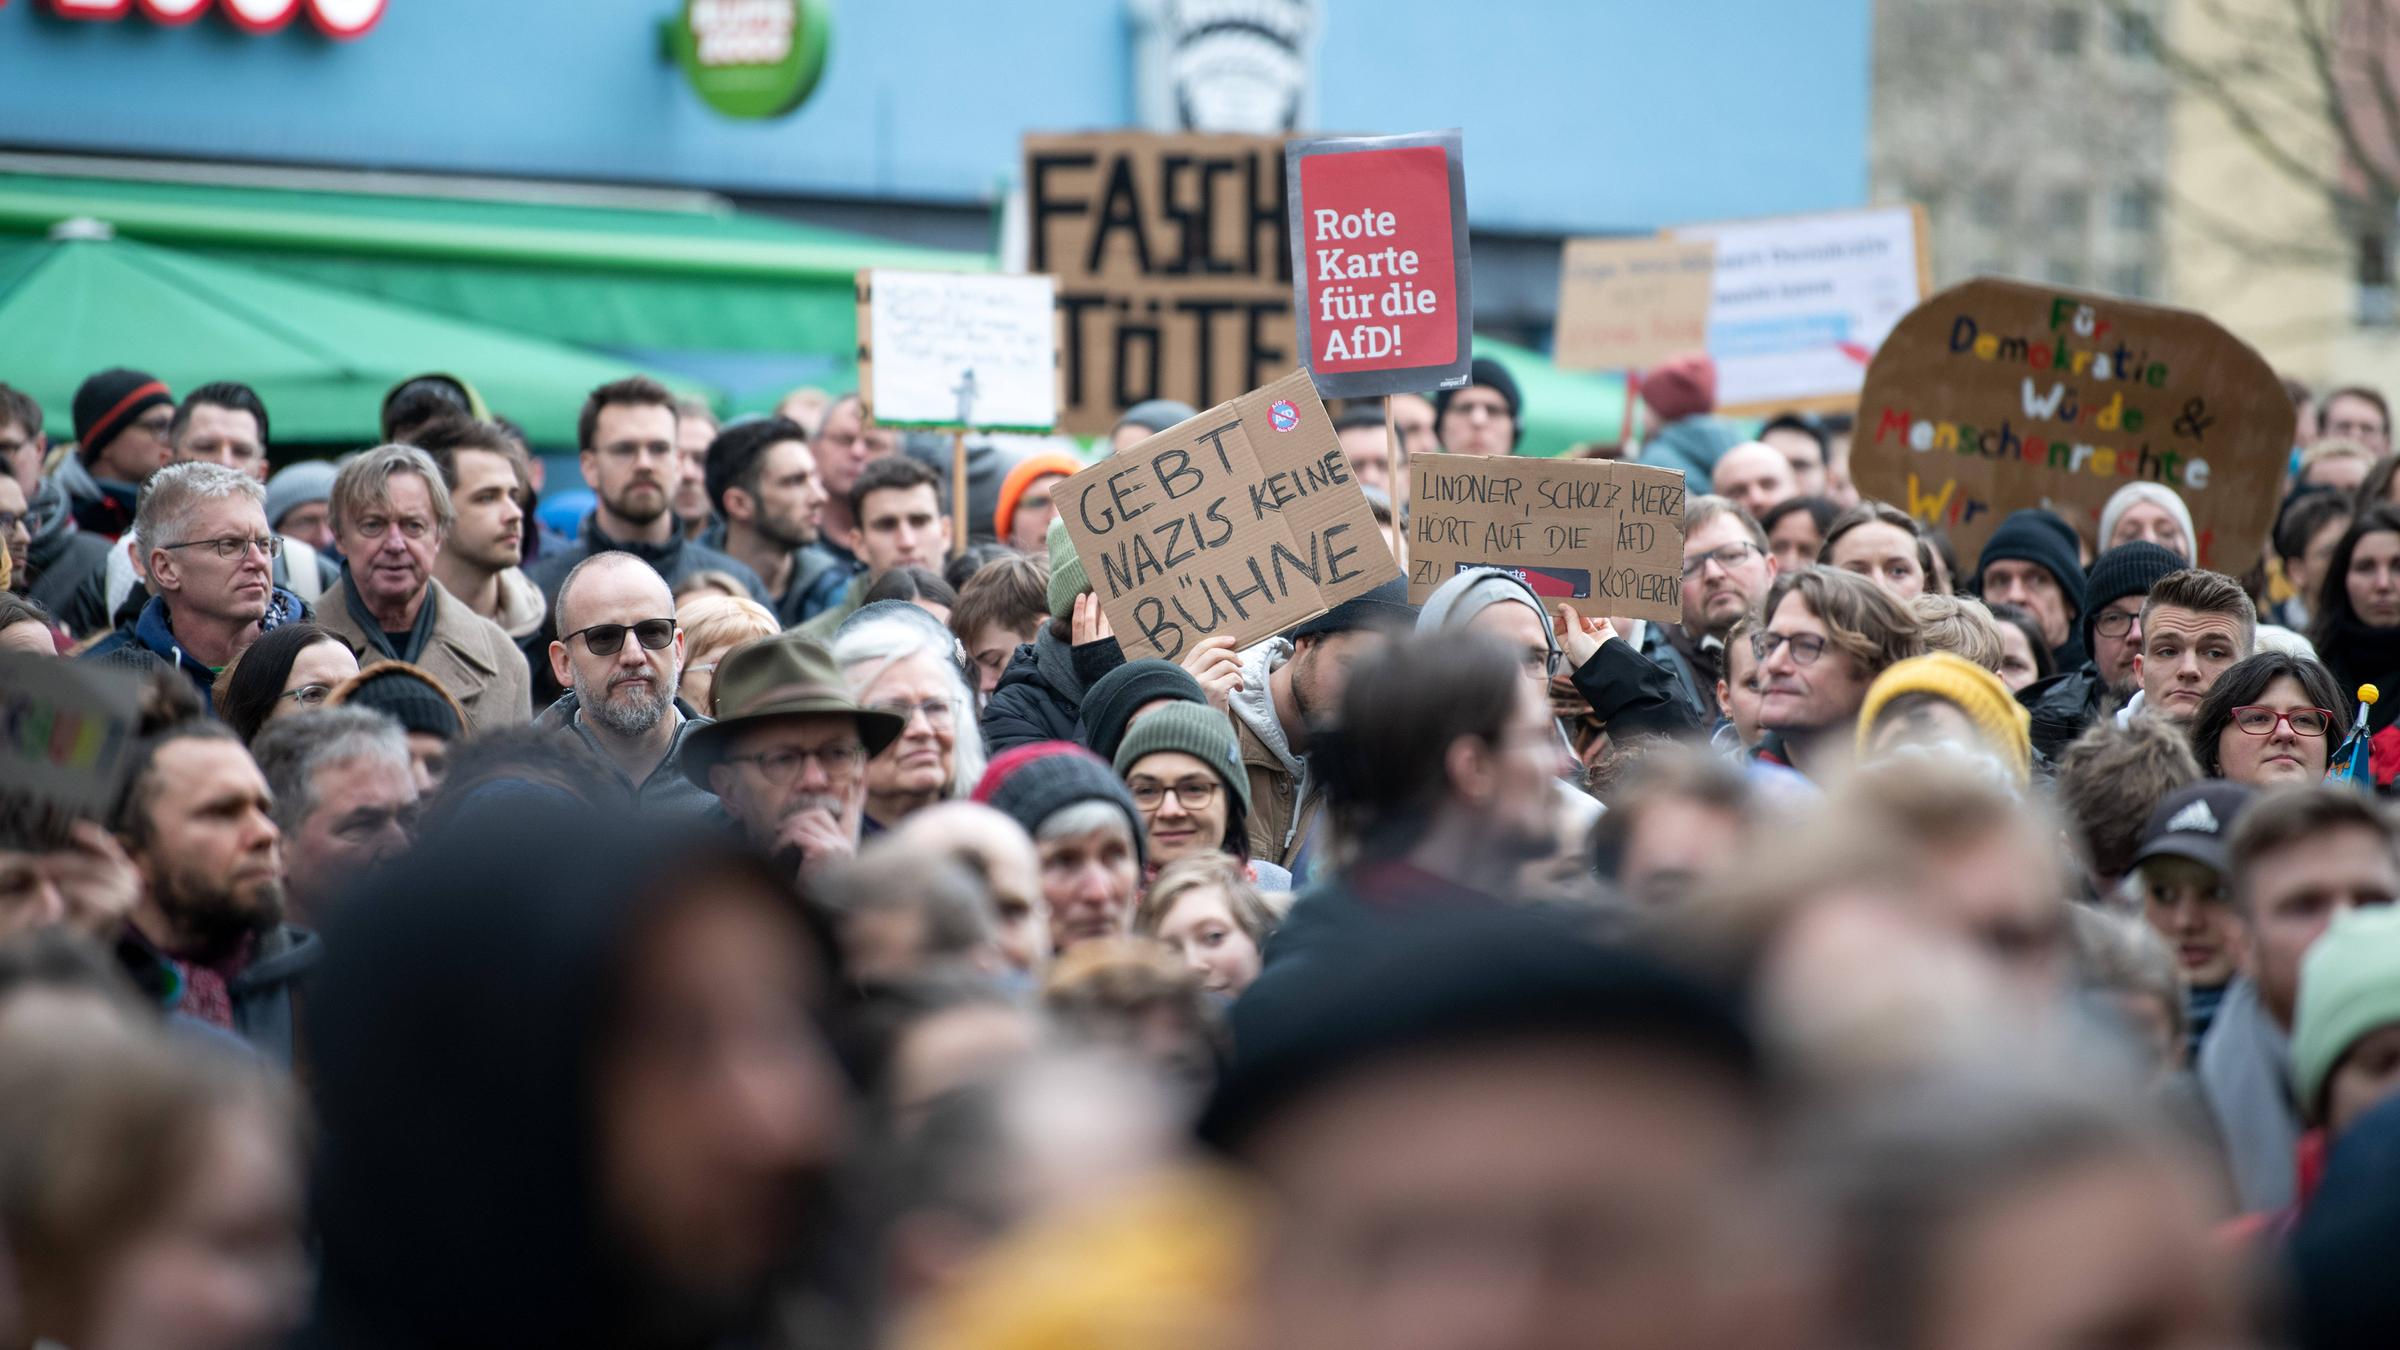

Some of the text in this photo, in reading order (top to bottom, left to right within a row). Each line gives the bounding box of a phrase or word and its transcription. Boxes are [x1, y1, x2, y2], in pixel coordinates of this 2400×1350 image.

[1314, 208, 1396, 240] Rote
[1316, 247, 1419, 281] Karte
[1320, 282, 1437, 321] für die
[2050, 298, 2112, 340] Für
[1323, 325, 1402, 361] AfD!
[1949, 315, 2168, 388] Demokratie
[2021, 377, 2215, 442] Würde &
[1874, 405, 2210, 489] Menschenrechte
[1080, 419, 1243, 535] GEBT
[1422, 472, 1683, 521] LINDNER, SCHOLZ, MERZ
[1907, 473, 1988, 527] Wir
[1100, 450, 1350, 599] NAZIS KEINE
[1418, 512, 1655, 556] HÖRT AUF DIE AFD
[1132, 523, 1366, 660] BÜHNE
[1412, 559, 1679, 606] ZU KOPIEREN
